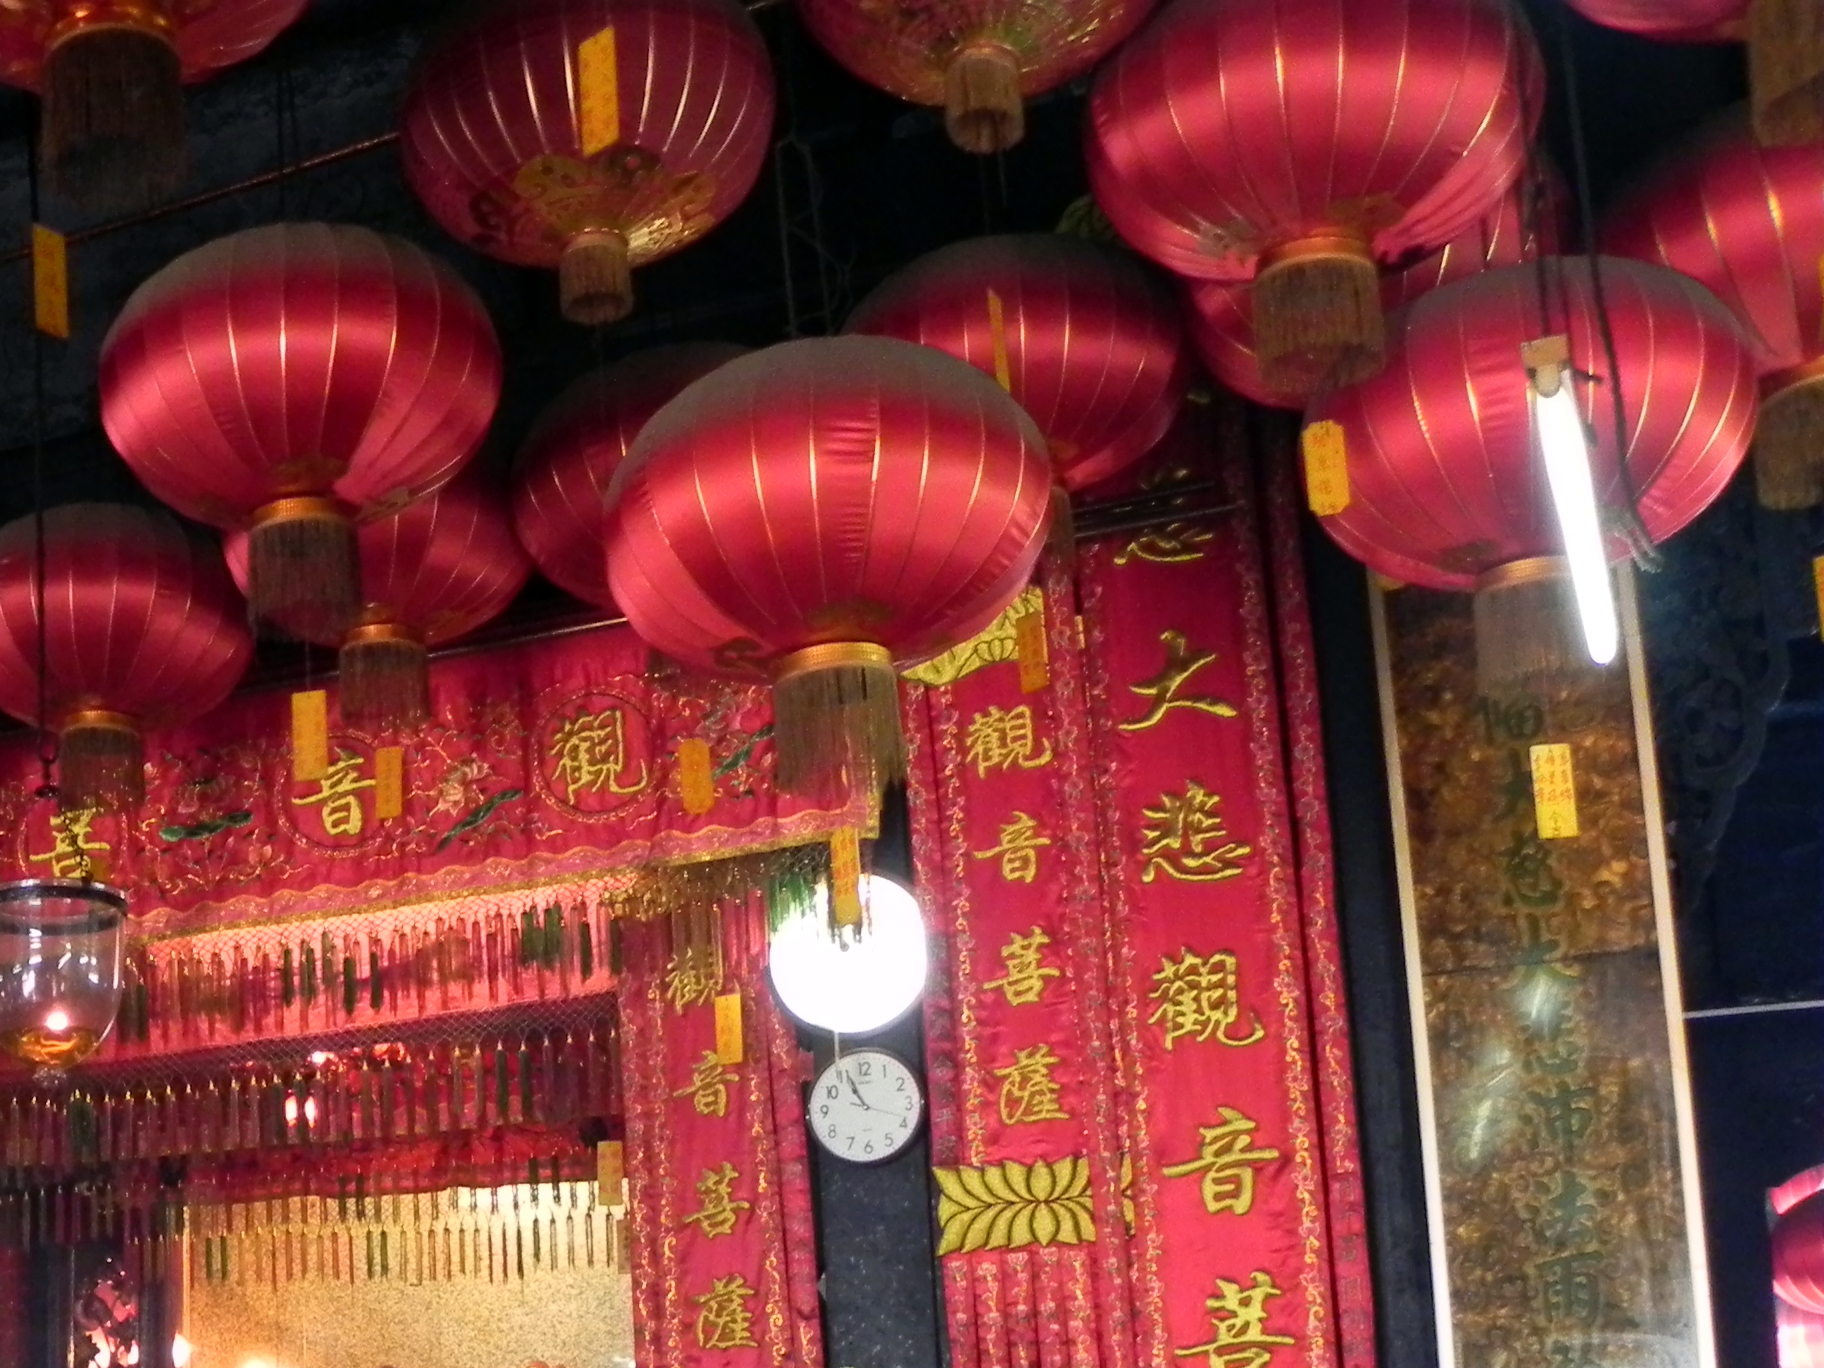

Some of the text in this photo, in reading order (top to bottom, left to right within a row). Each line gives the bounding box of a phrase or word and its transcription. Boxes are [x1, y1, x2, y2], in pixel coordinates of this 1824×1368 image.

[965, 704, 1070, 1126] 觀音菩薩
[858, 1061, 871, 1076] 12
[895, 1077, 905, 1092] 2
[826, 1085, 839, 1100] 10
[904, 1095, 914, 1111] 3
[819, 1104, 829, 1119] 9
[899, 1117, 908, 1129] 4
[828, 1124, 837, 1139] 8
[846, 1136, 855, 1151] 7
[863, 1140, 874, 1154] 6
[884, 1132, 894, 1147] 5
